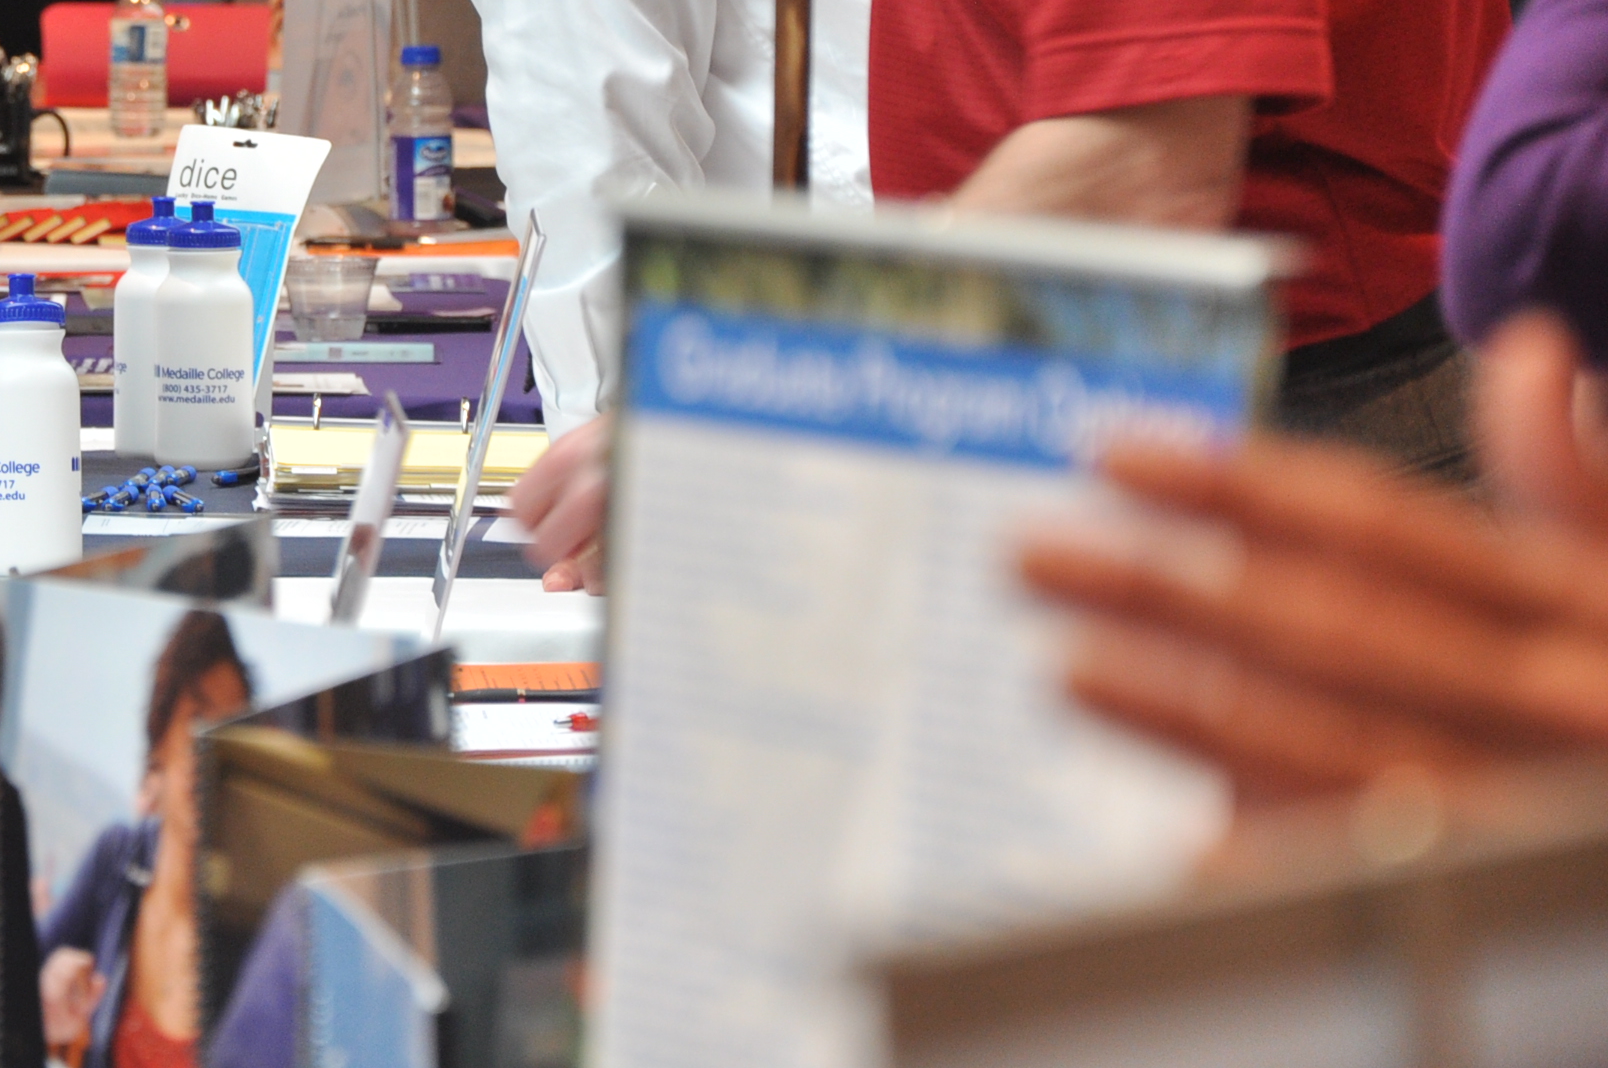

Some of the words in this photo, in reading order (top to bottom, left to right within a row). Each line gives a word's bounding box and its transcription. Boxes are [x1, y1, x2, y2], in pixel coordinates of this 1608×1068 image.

[179, 158, 238, 190] dice
[161, 367, 205, 380] Medaille
[207, 368, 245, 382] College
[162, 384, 182, 394] (800)
[183, 385, 228, 393] 435-3717
[157, 395, 235, 403] www.medaille.edu
